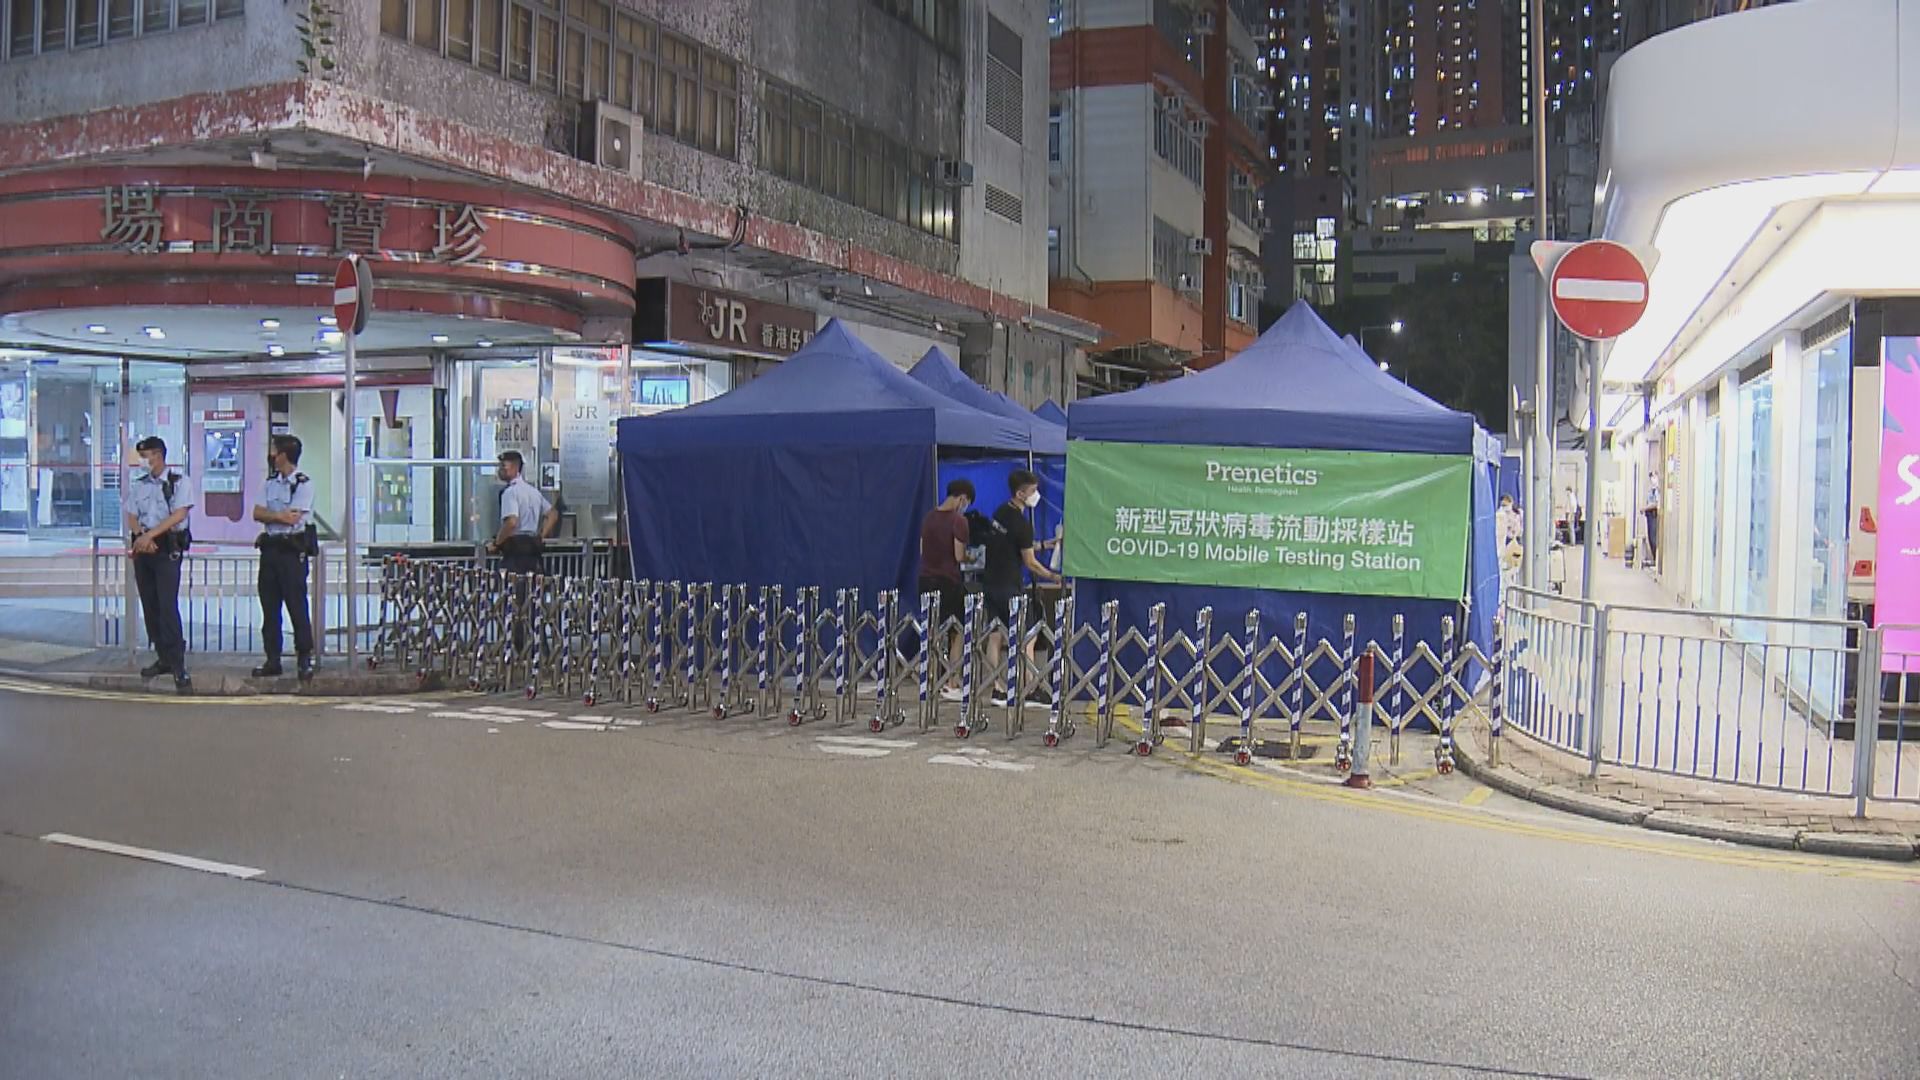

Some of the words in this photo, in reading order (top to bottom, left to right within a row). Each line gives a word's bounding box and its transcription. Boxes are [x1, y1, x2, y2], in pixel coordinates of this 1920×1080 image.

[711, 297, 748, 344] JR
[501, 403, 524, 420] JR
[574, 406, 599, 420] JR
[513, 423, 529, 442] Cut
[1205, 460, 1318, 486] Prenetics
[1115, 505, 1415, 548] 新型冠狀病毒流動採樣站
[1106, 537, 1200, 560] COVID-19
[1205, 542, 1270, 564] Mobile
[1275, 546, 1345, 571] Testing
[1350, 550, 1421, 572] Station
